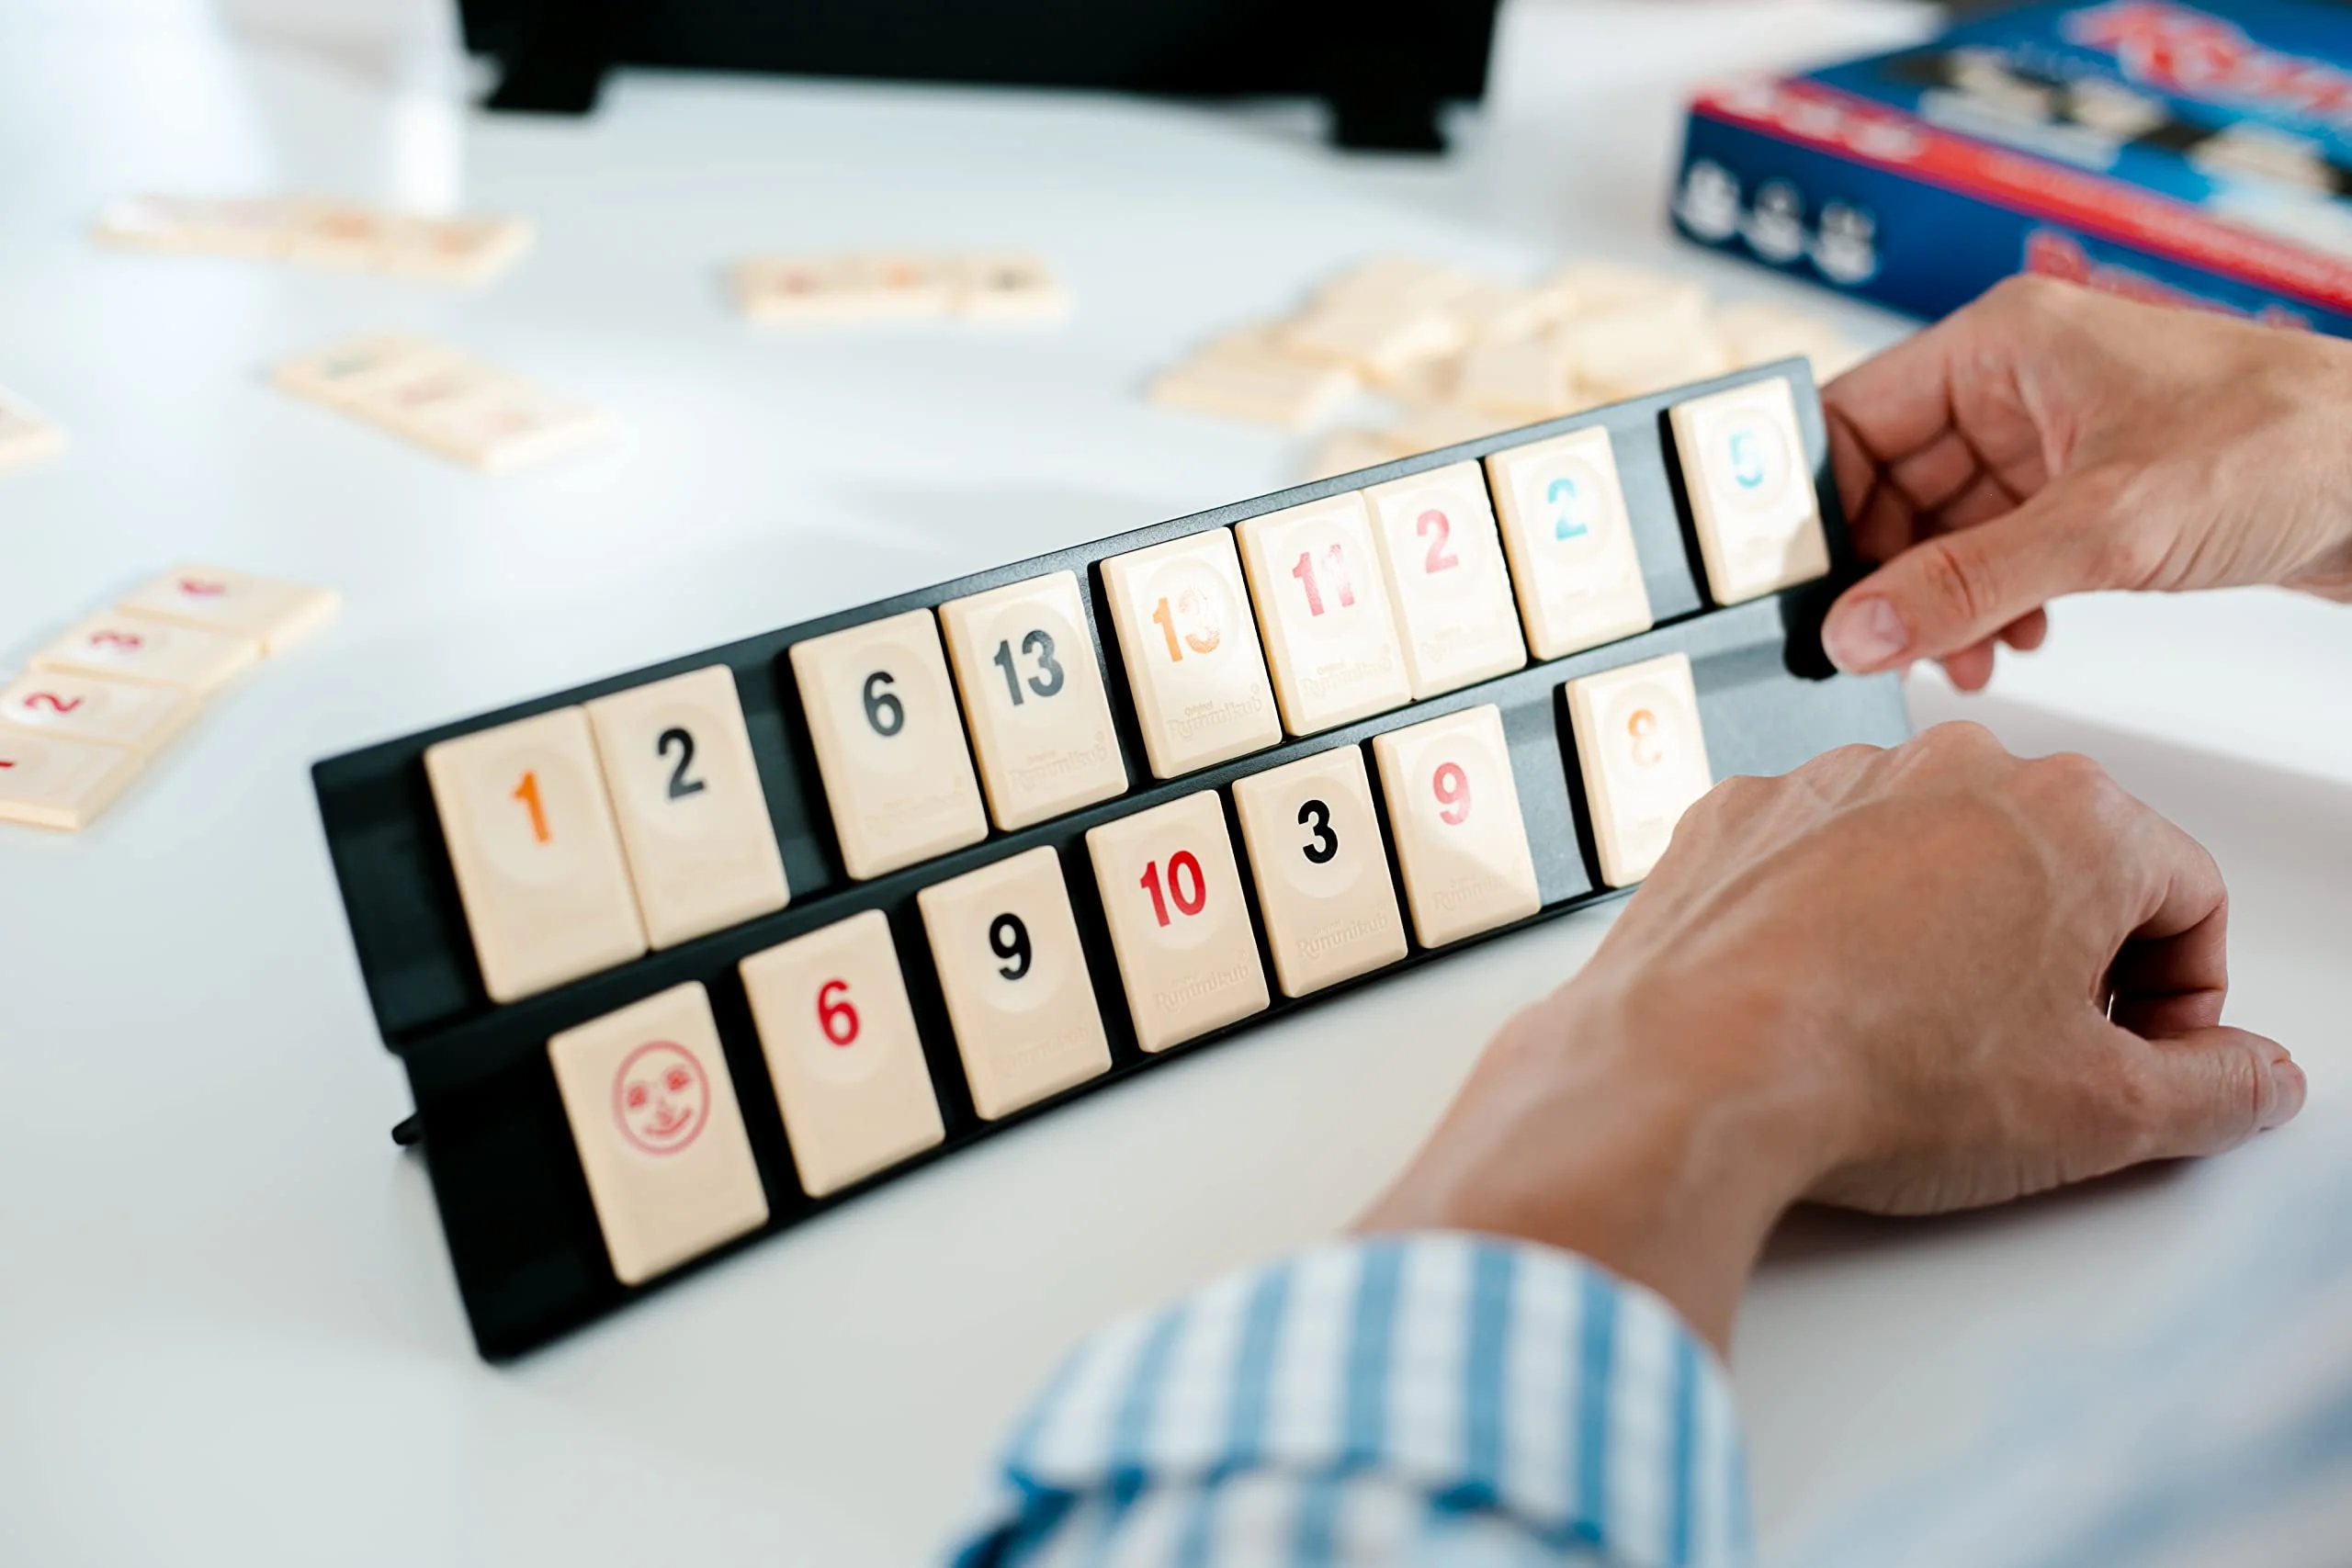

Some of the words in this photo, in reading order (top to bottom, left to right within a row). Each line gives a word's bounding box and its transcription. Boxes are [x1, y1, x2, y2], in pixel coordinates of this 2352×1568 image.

[1416, 508, 1459, 574] 2
[1546, 477, 1589, 542] 2
[1292, 543, 1354, 617] 11
[1152, 584, 1221, 662] 13
[993, 629, 1065, 706] 13
[24, 692, 84, 713] 2
[864, 671, 905, 737] 6
[658, 727, 706, 799] 2
[1432, 761, 1472, 826] 9
[513, 770, 551, 843] 1
[1297, 799, 1339, 864] 3
[1139, 850, 1206, 928] 10
[989, 912, 1032, 981] 9
[816, 978, 861, 1048] 6
